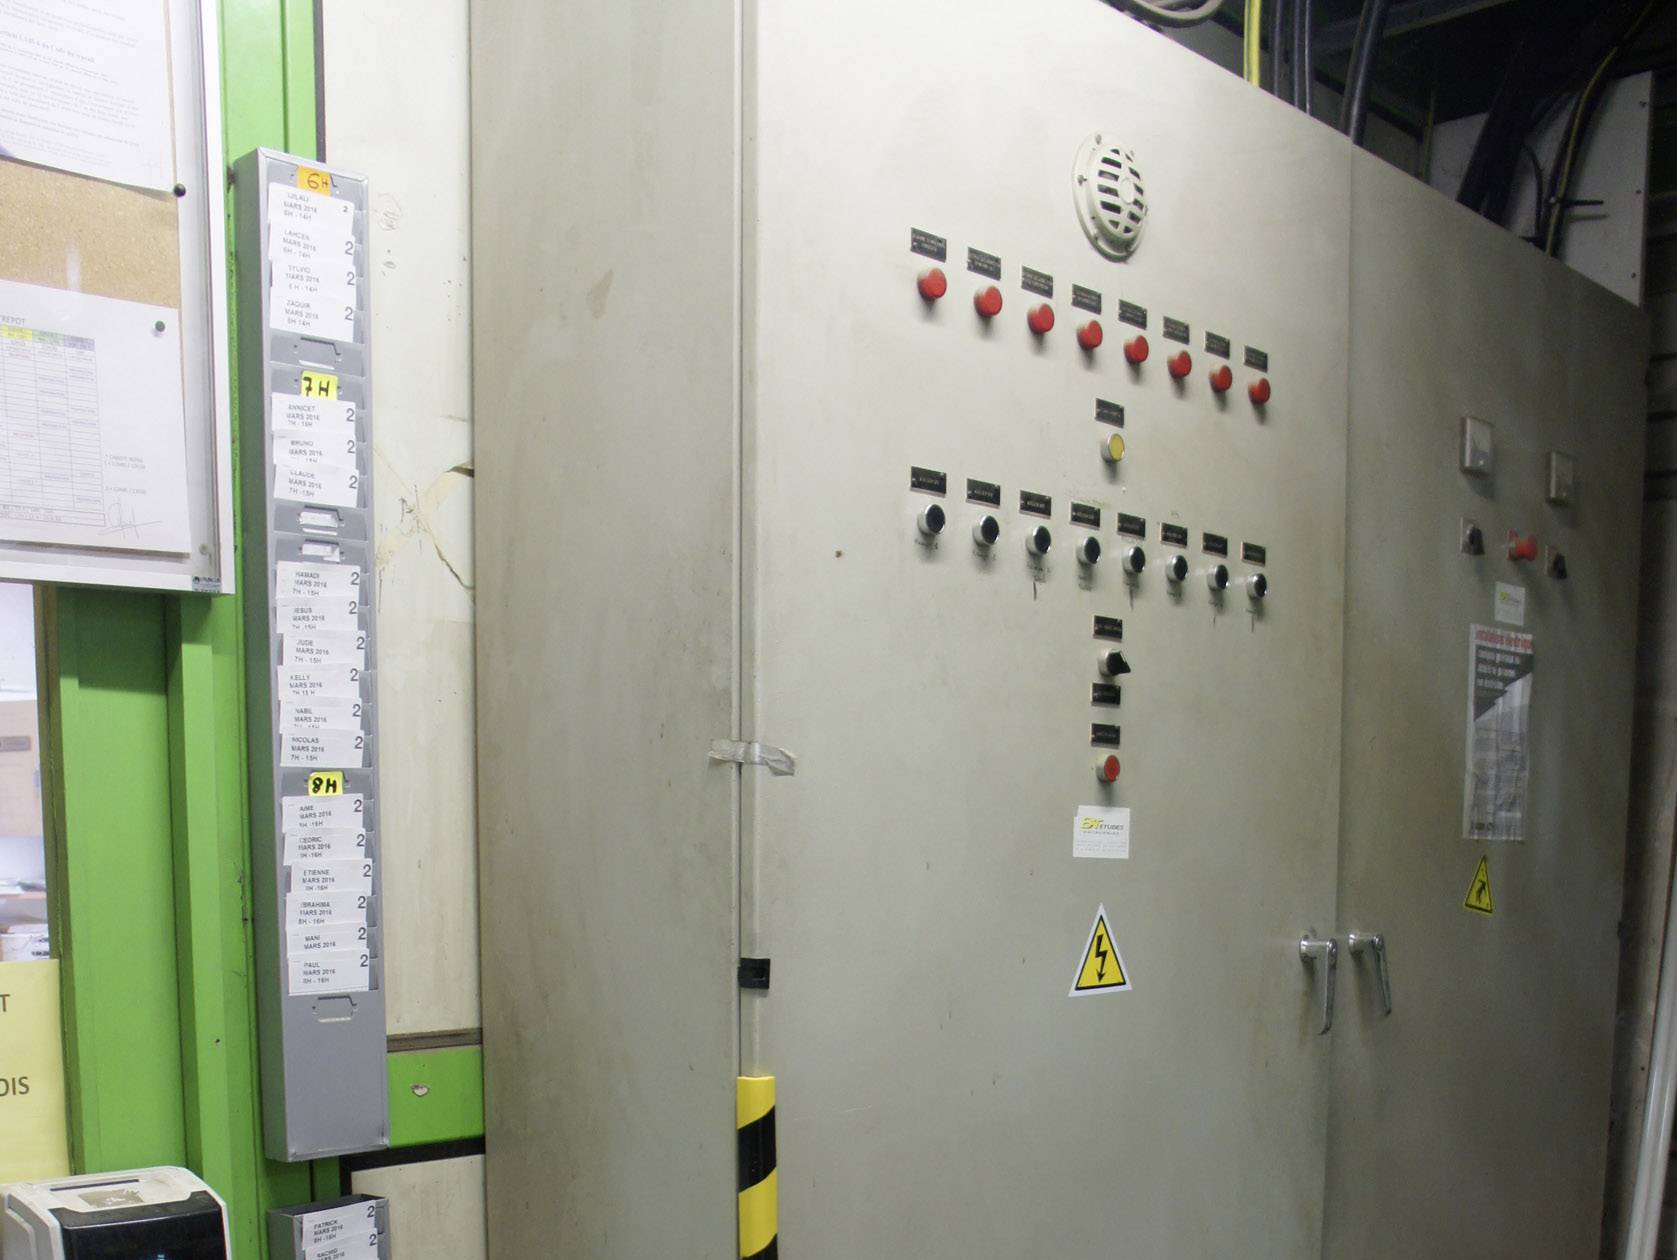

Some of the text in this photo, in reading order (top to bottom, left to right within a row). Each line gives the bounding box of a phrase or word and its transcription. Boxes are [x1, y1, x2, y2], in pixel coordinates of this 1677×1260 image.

[344, 240, 354, 256] 2
[346, 272, 355, 286] 2
[344, 306, 353, 320] 2
[346, 408, 354, 422] 2
[347, 440, 355, 454] 2
[349, 475, 358, 489] 2
[350, 572, 360, 586] 2
[349, 600, 358, 614] 2
[356, 636, 366, 650] 2
[350, 668, 359, 682] 2
[352, 704, 361, 718] 2
[354, 736, 364, 750] 2
[312, 777, 337, 794] 8H
[354, 799, 362, 812] 2
[357, 834, 366, 847] 2
[364, 864, 372, 877] 2
[358, 896, 366, 909] 2
[358, 927, 366, 940] 2
[360, 954, 368, 968] 2
[367, 1205, 375, 1218] 2
[369, 1234, 377, 1246] 2
